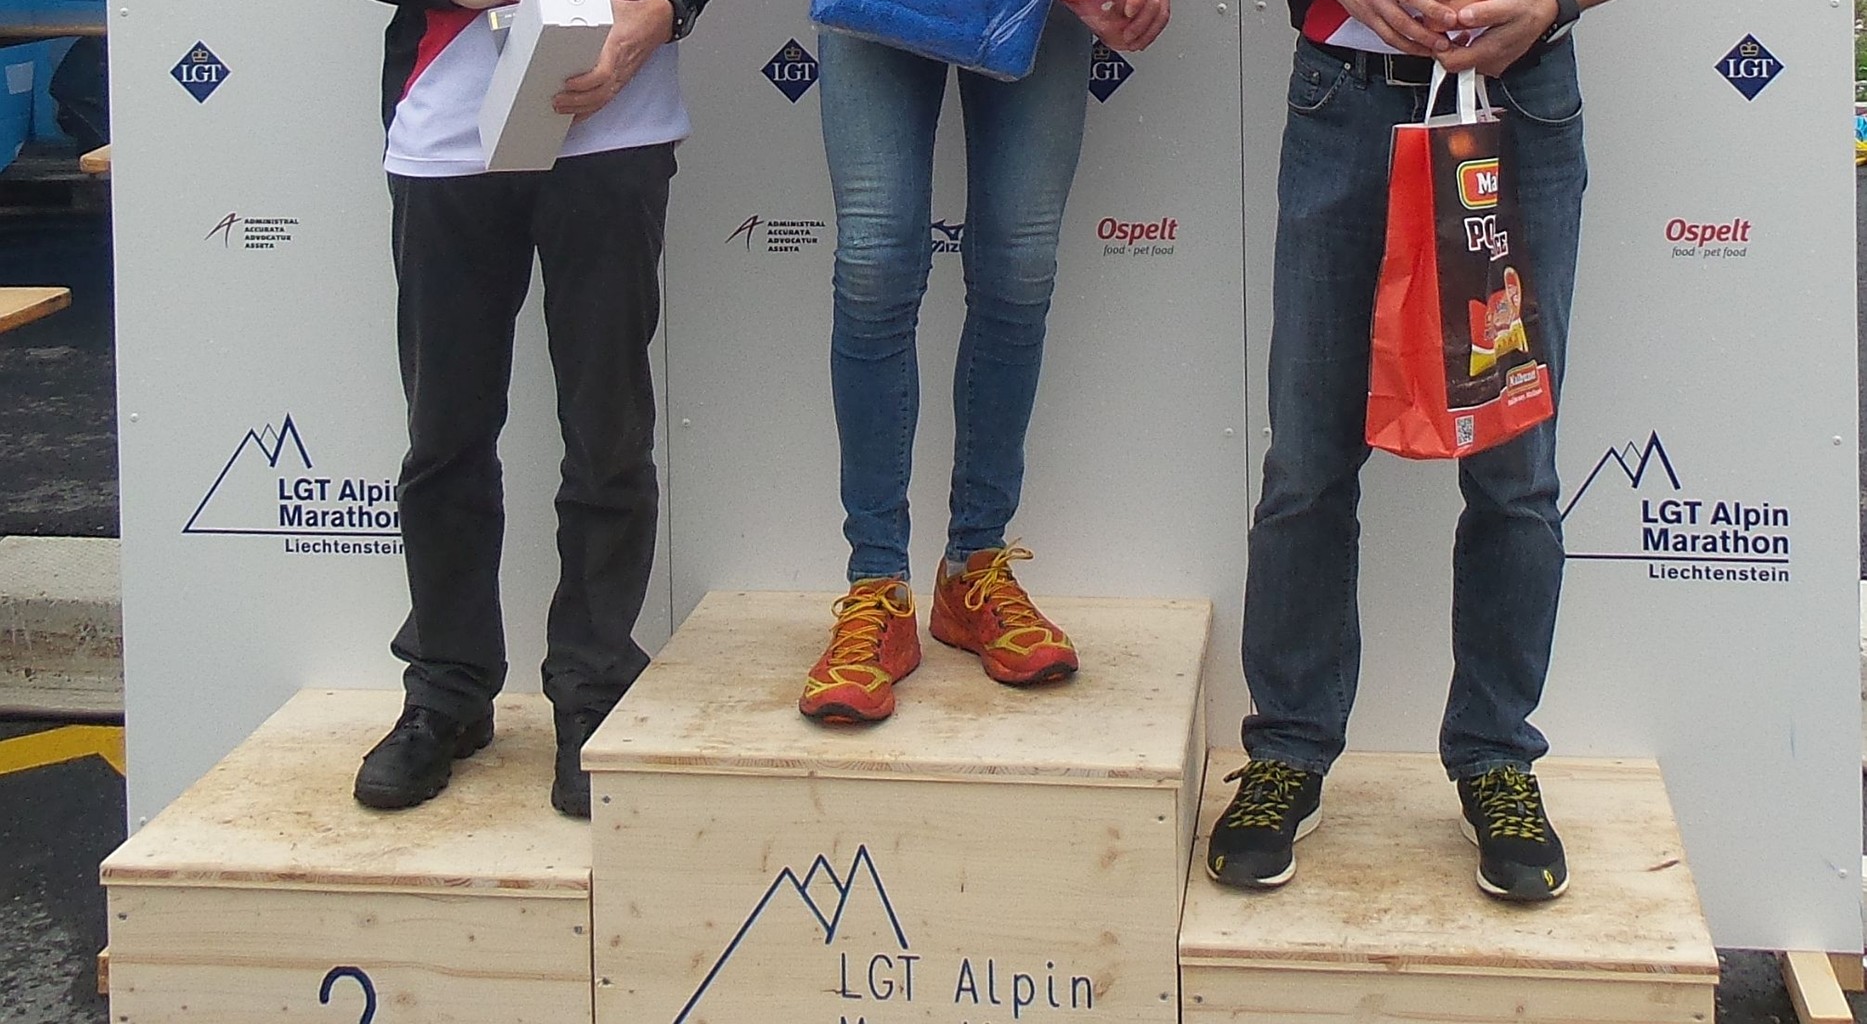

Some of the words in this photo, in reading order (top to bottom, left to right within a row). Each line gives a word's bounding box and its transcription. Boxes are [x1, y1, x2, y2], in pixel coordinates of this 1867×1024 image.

[181, 63, 222, 84] LGT
[772, 62, 815, 81] LGT
[1090, 61, 1125, 81] GT
[1727, 57, 1774, 80] LGT
[1097, 217, 1178, 246] Ospelt
[1666, 218, 1751, 248] Ospelt
[1103, 244, 1126, 256] food
[1133, 245, 1150, 257] pet
[1151, 245, 1174, 256] food
[1671, 246, 1696, 258] food
[1703, 248, 1721, 259] pet
[1722, 246, 1747, 259] food
[279, 478, 331, 501] LGT
[1642, 500, 1702, 525] LGT
[1710, 502, 1788, 531] Alpin
[1642, 527, 1789, 554] Marathon
[1649, 564, 1789, 582] Liechtenstein
[841, 952, 920, 1001] LGT
[954, 958, 1092, 1019] Alpin
